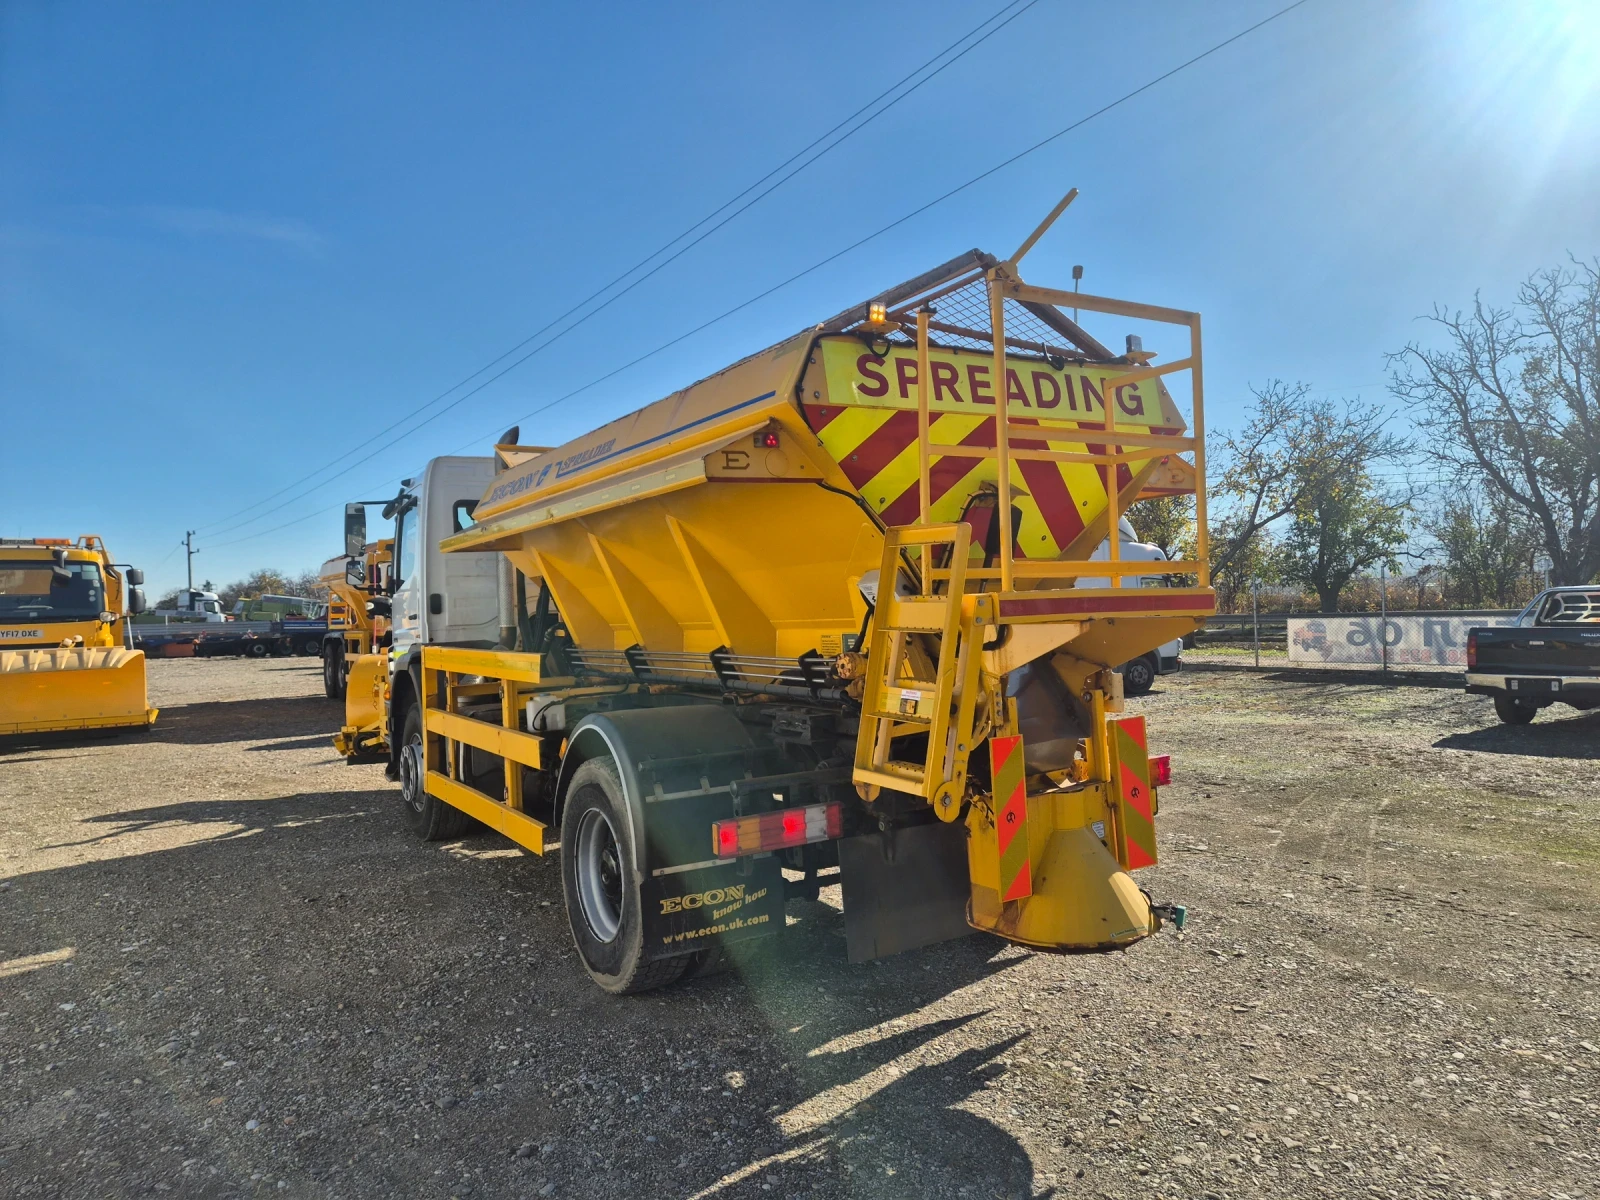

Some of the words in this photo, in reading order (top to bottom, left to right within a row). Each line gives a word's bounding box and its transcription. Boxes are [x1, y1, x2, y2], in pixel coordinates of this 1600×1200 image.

[856, 353, 1145, 417] SPREADING
[721, 450, 750, 470] E
[1, 630, 19, 638] YF17
[659, 884, 745, 915] ECON
[712, 898, 743, 921] know
[745, 887, 767, 905] how
[662, 912, 770, 945] www.econ.uk.com
